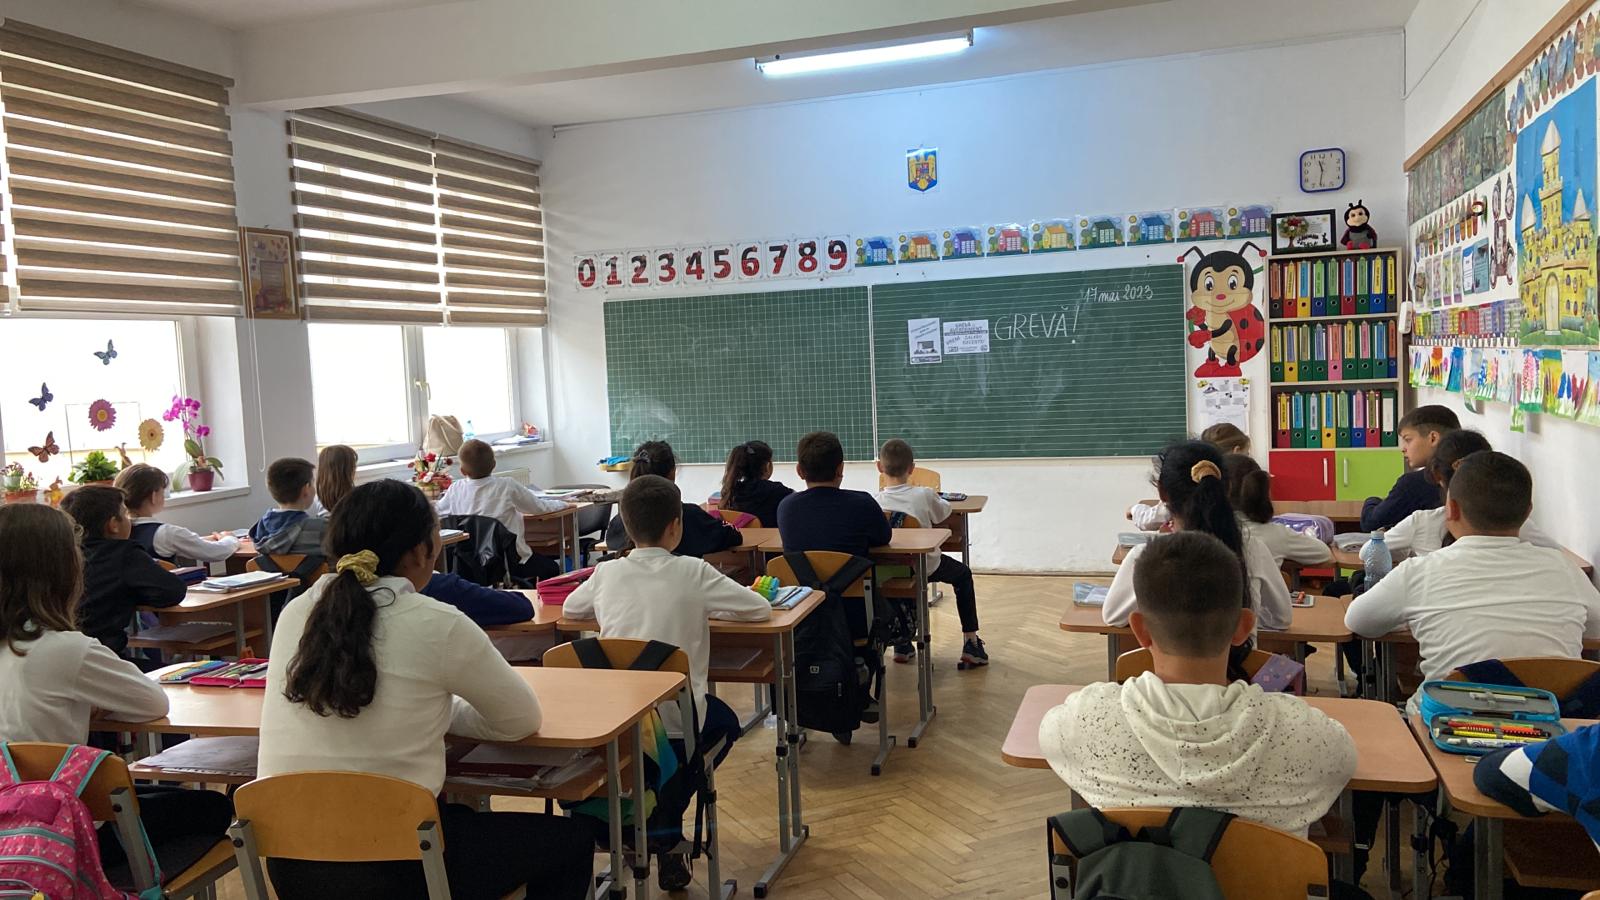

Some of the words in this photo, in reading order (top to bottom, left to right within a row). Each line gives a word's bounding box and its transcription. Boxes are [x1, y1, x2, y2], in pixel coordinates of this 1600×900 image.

[578, 258, 596, 287] 0
[605, 256, 622, 285] 1
[631, 254, 648, 283] 2
[658, 252, 676, 282] 3
[684, 250, 704, 280] 4
[713, 248, 731, 278] 5
[741, 245, 760, 276] 6
[769, 244, 788, 274] 7
[798, 240, 818, 272] 8
[827, 240, 847, 270] 9
[1084, 287, 1098, 302] 17
[1098, 291, 1120, 302] mai
[1122, 284, 1153, 300] 2023
[994, 304, 1080, 344] GREVĂ!
